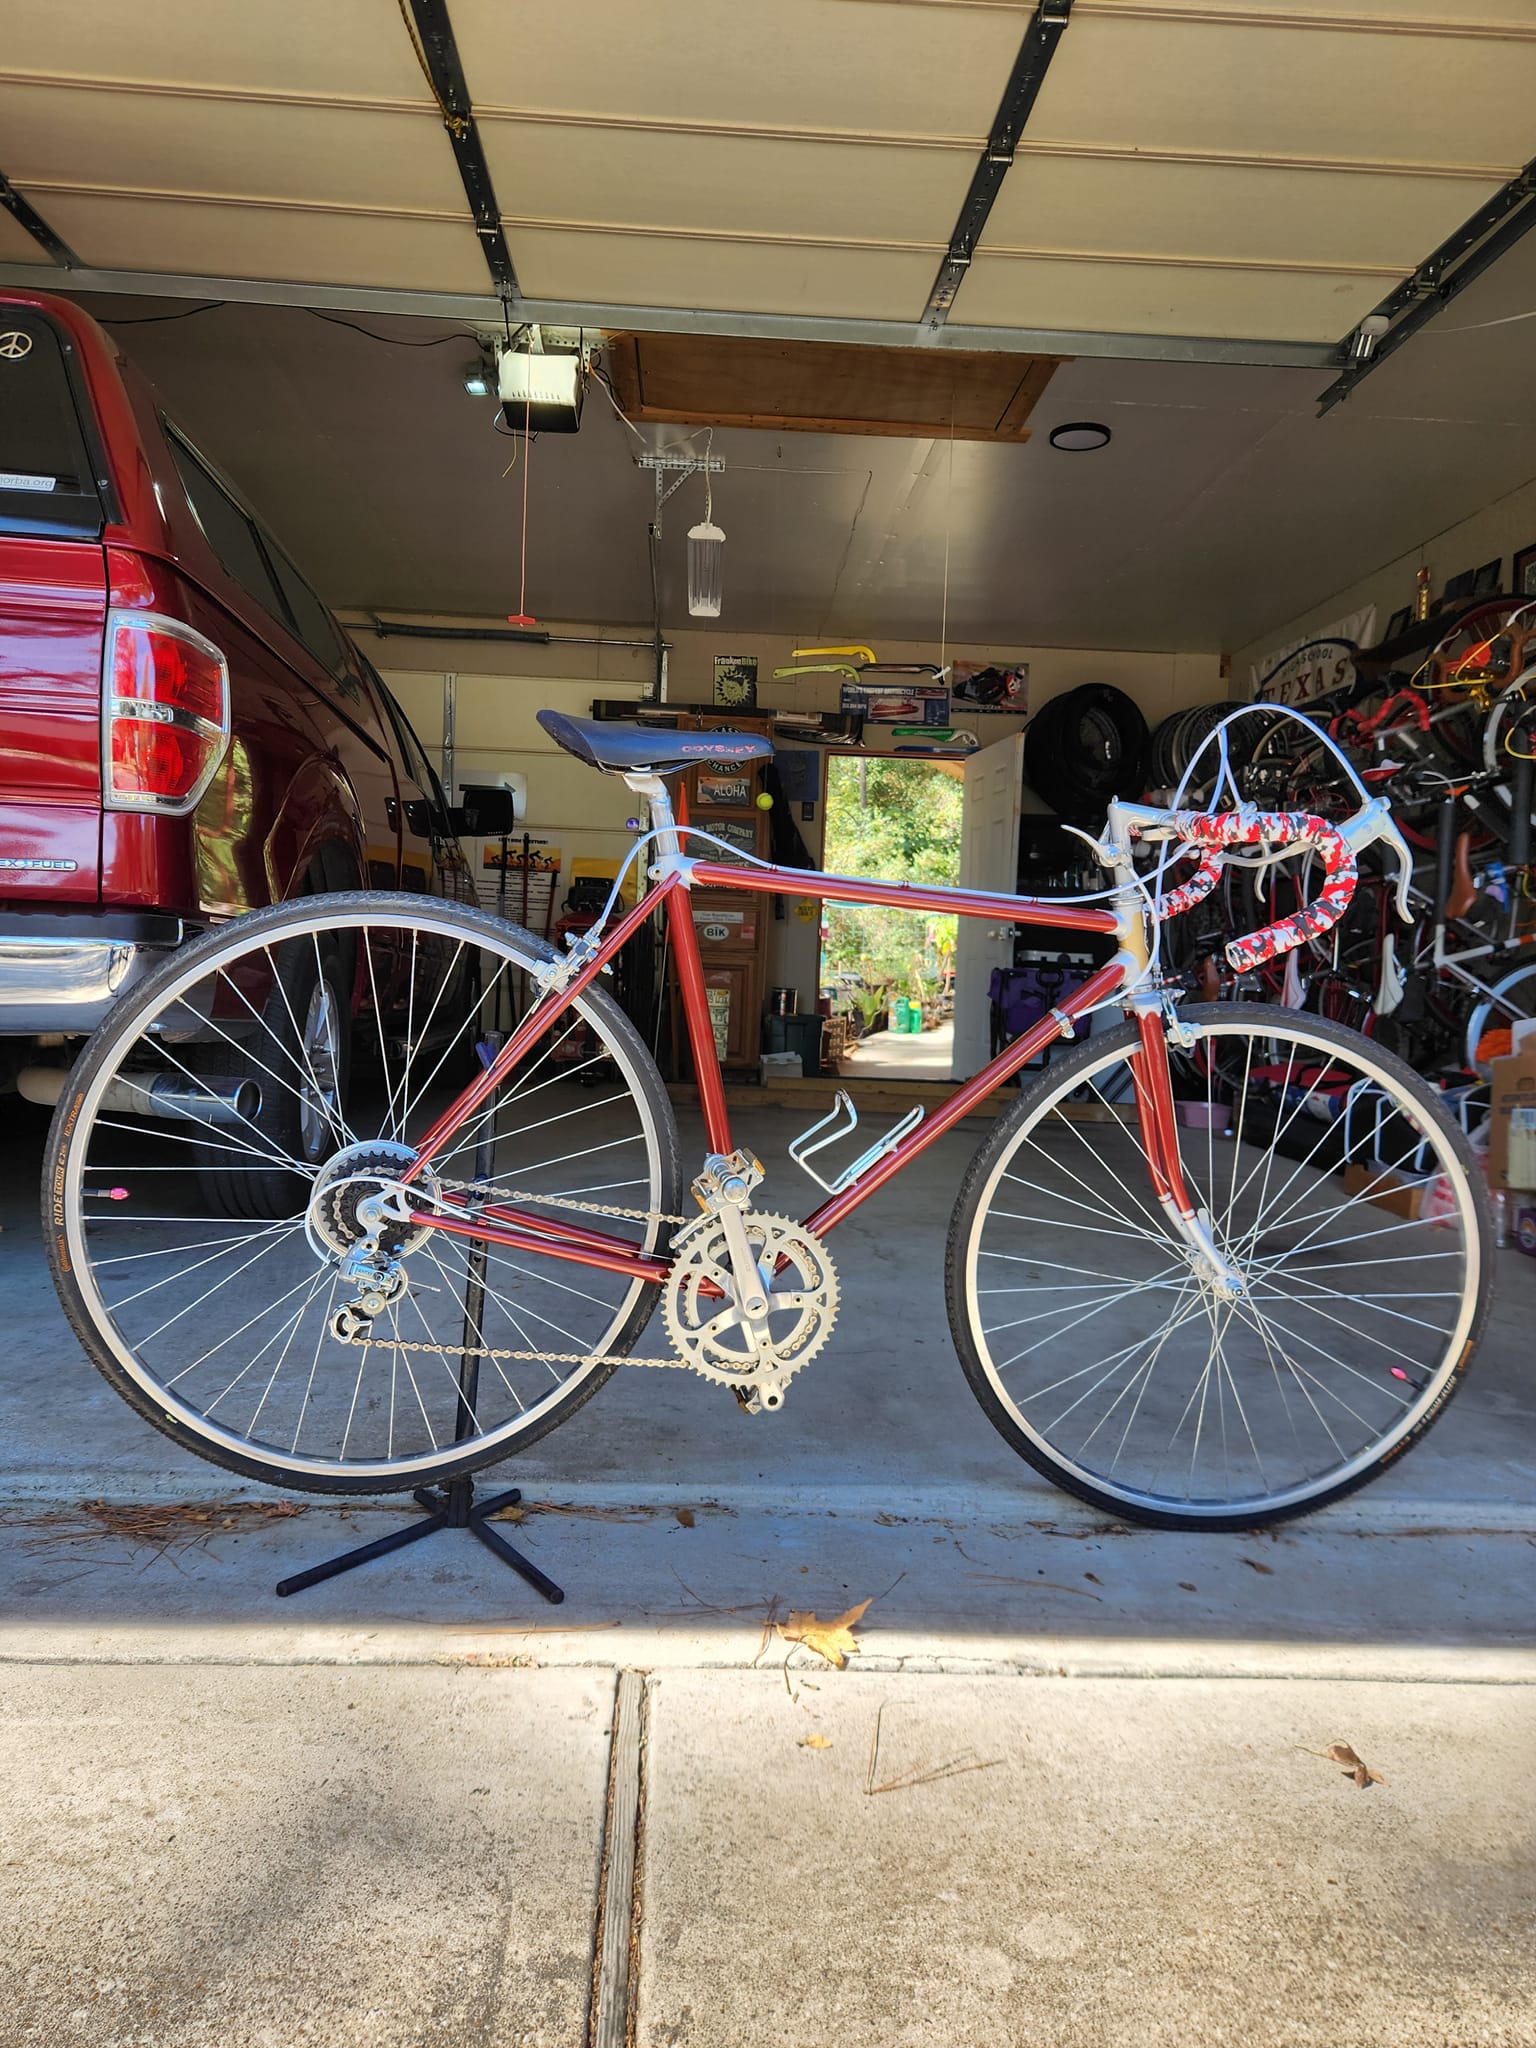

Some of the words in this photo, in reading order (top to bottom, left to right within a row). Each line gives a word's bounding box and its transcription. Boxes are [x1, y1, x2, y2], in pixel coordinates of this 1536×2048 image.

[1263, 656, 1348, 706] TEXAS
[713, 784, 747, 798] ALOHA
[32, 860, 74, 869] FUEL
[54, 1164, 65, 1194] TOUR
[53, 1192, 65, 1226] RIDE
